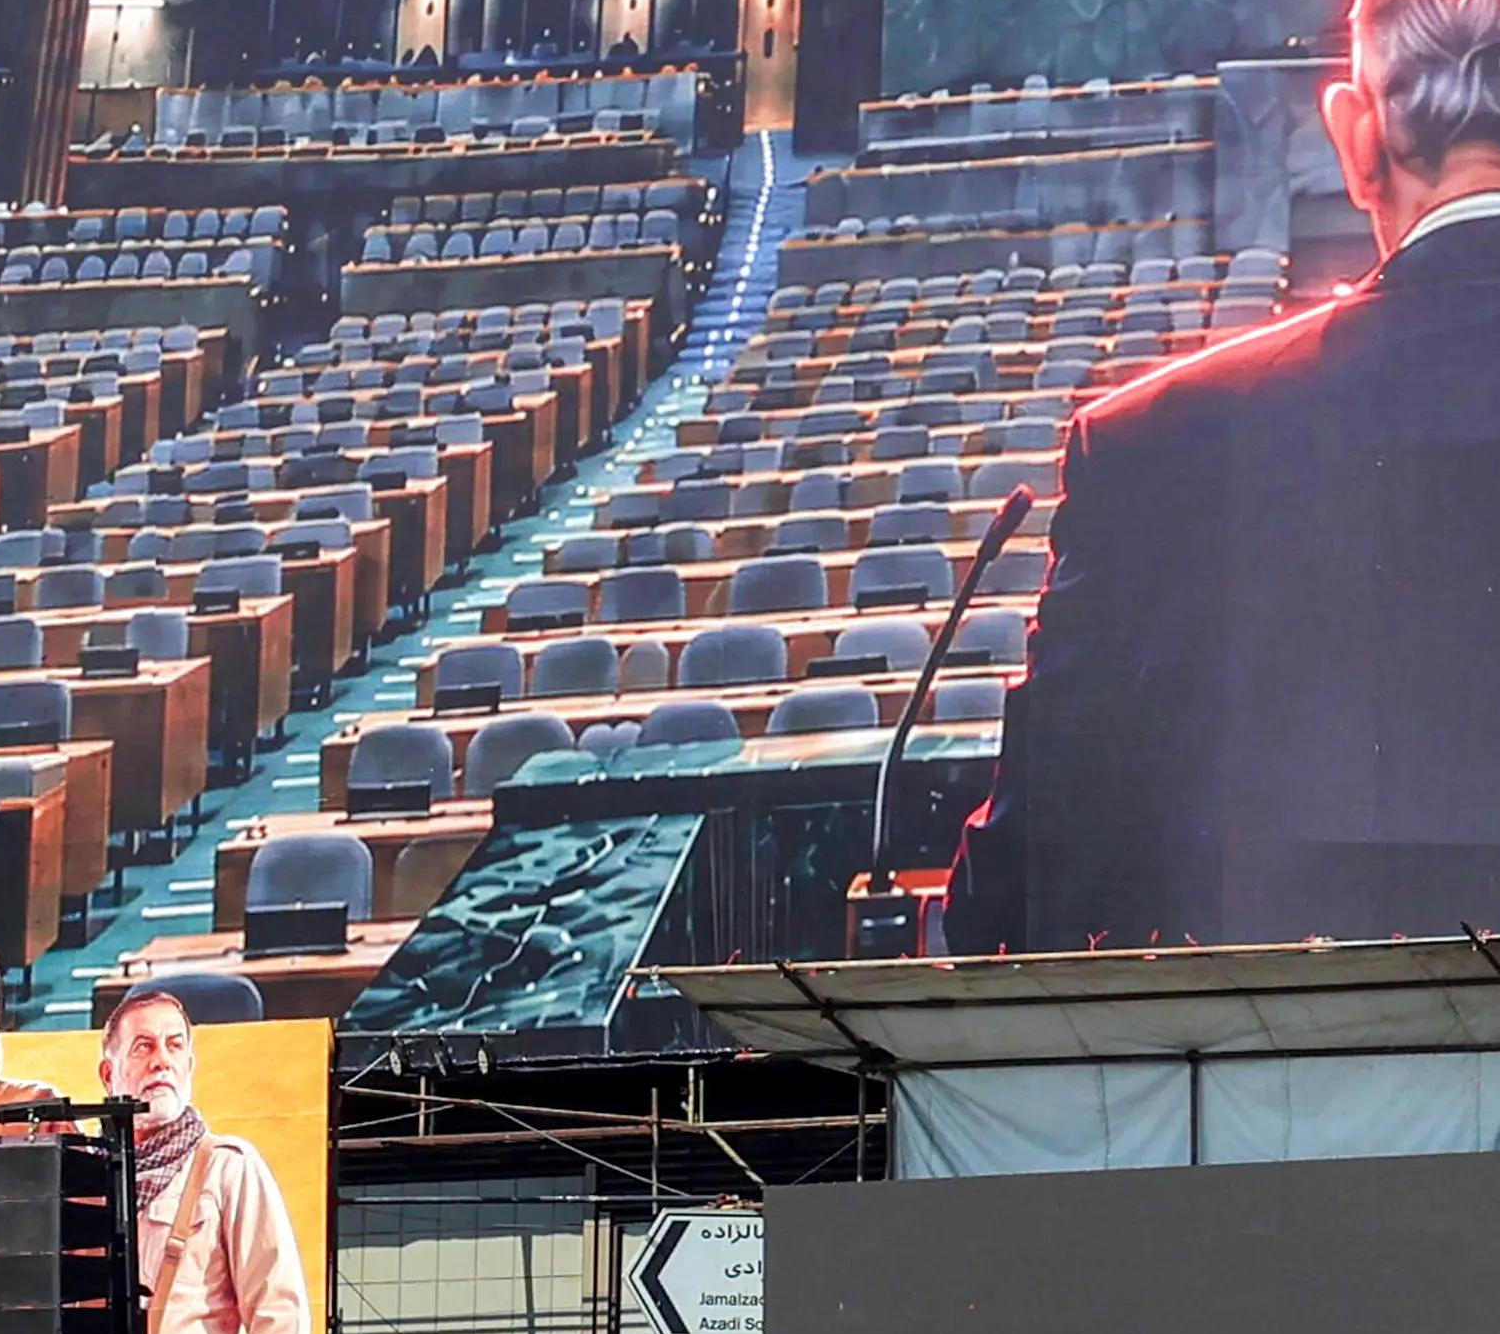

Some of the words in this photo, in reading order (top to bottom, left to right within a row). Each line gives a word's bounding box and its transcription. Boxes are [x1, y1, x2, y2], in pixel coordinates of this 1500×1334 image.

[701, 1224, 763, 1244] الزاده
[724, 1259, 762, 1279] ادی
[699, 1316, 740, 1331] Azadi
